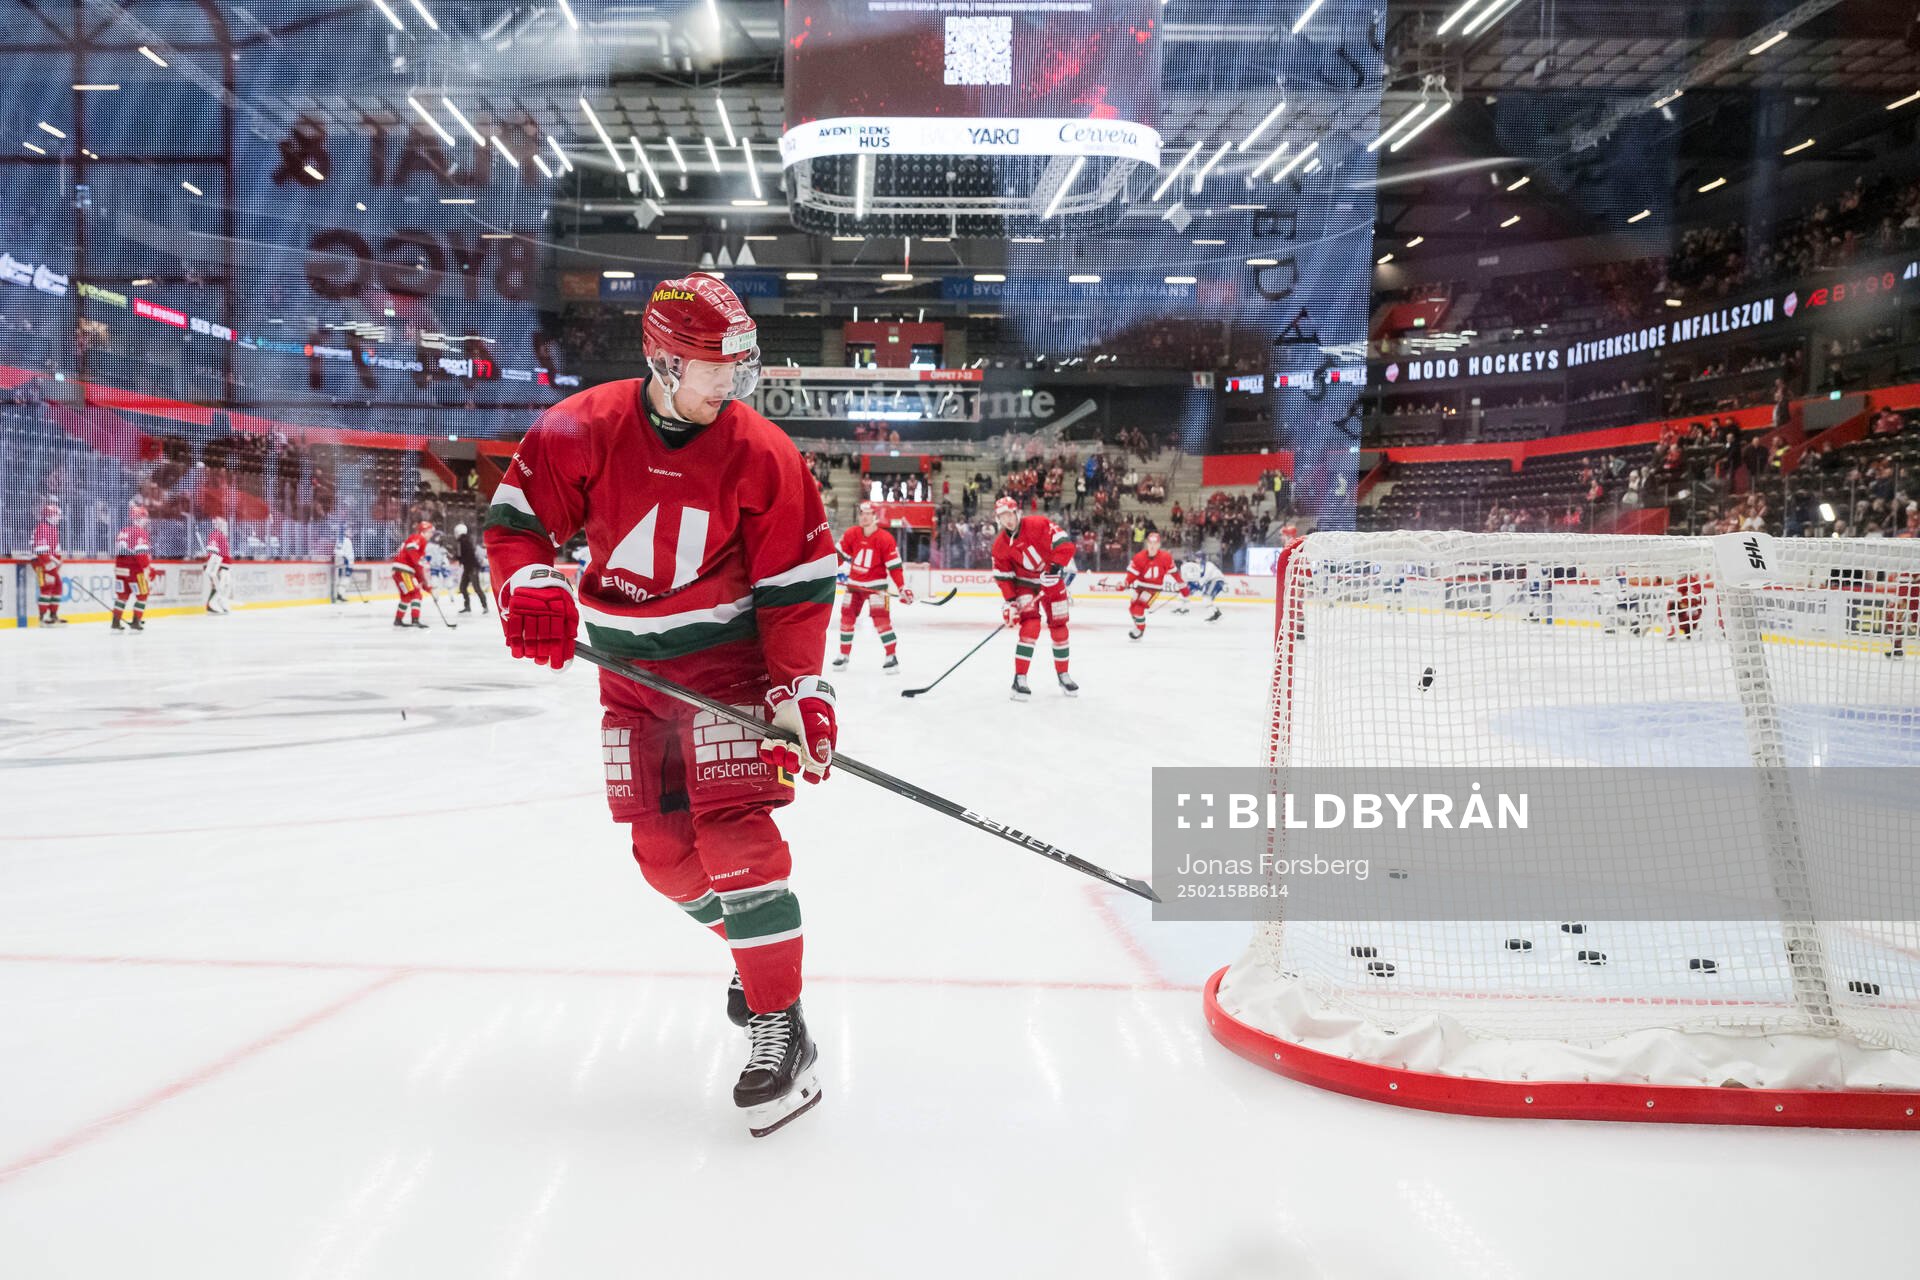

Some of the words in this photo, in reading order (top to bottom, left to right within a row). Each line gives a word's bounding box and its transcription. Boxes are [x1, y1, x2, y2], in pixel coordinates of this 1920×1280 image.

[859, 136, 890, 148] HUS
[1058, 122, 1137, 145] Cervera
[652, 289, 695, 302] Malux
[1408, 358, 1459, 381] MODO
[1468, 350, 1559, 376] HOCKEYS
[1671, 298, 1774, 344] ANFALLSZON
[914, 383, 1055, 420] Värme
[1743, 537, 1766, 570] SHL
[696, 761, 770, 782] Lerstenen.
